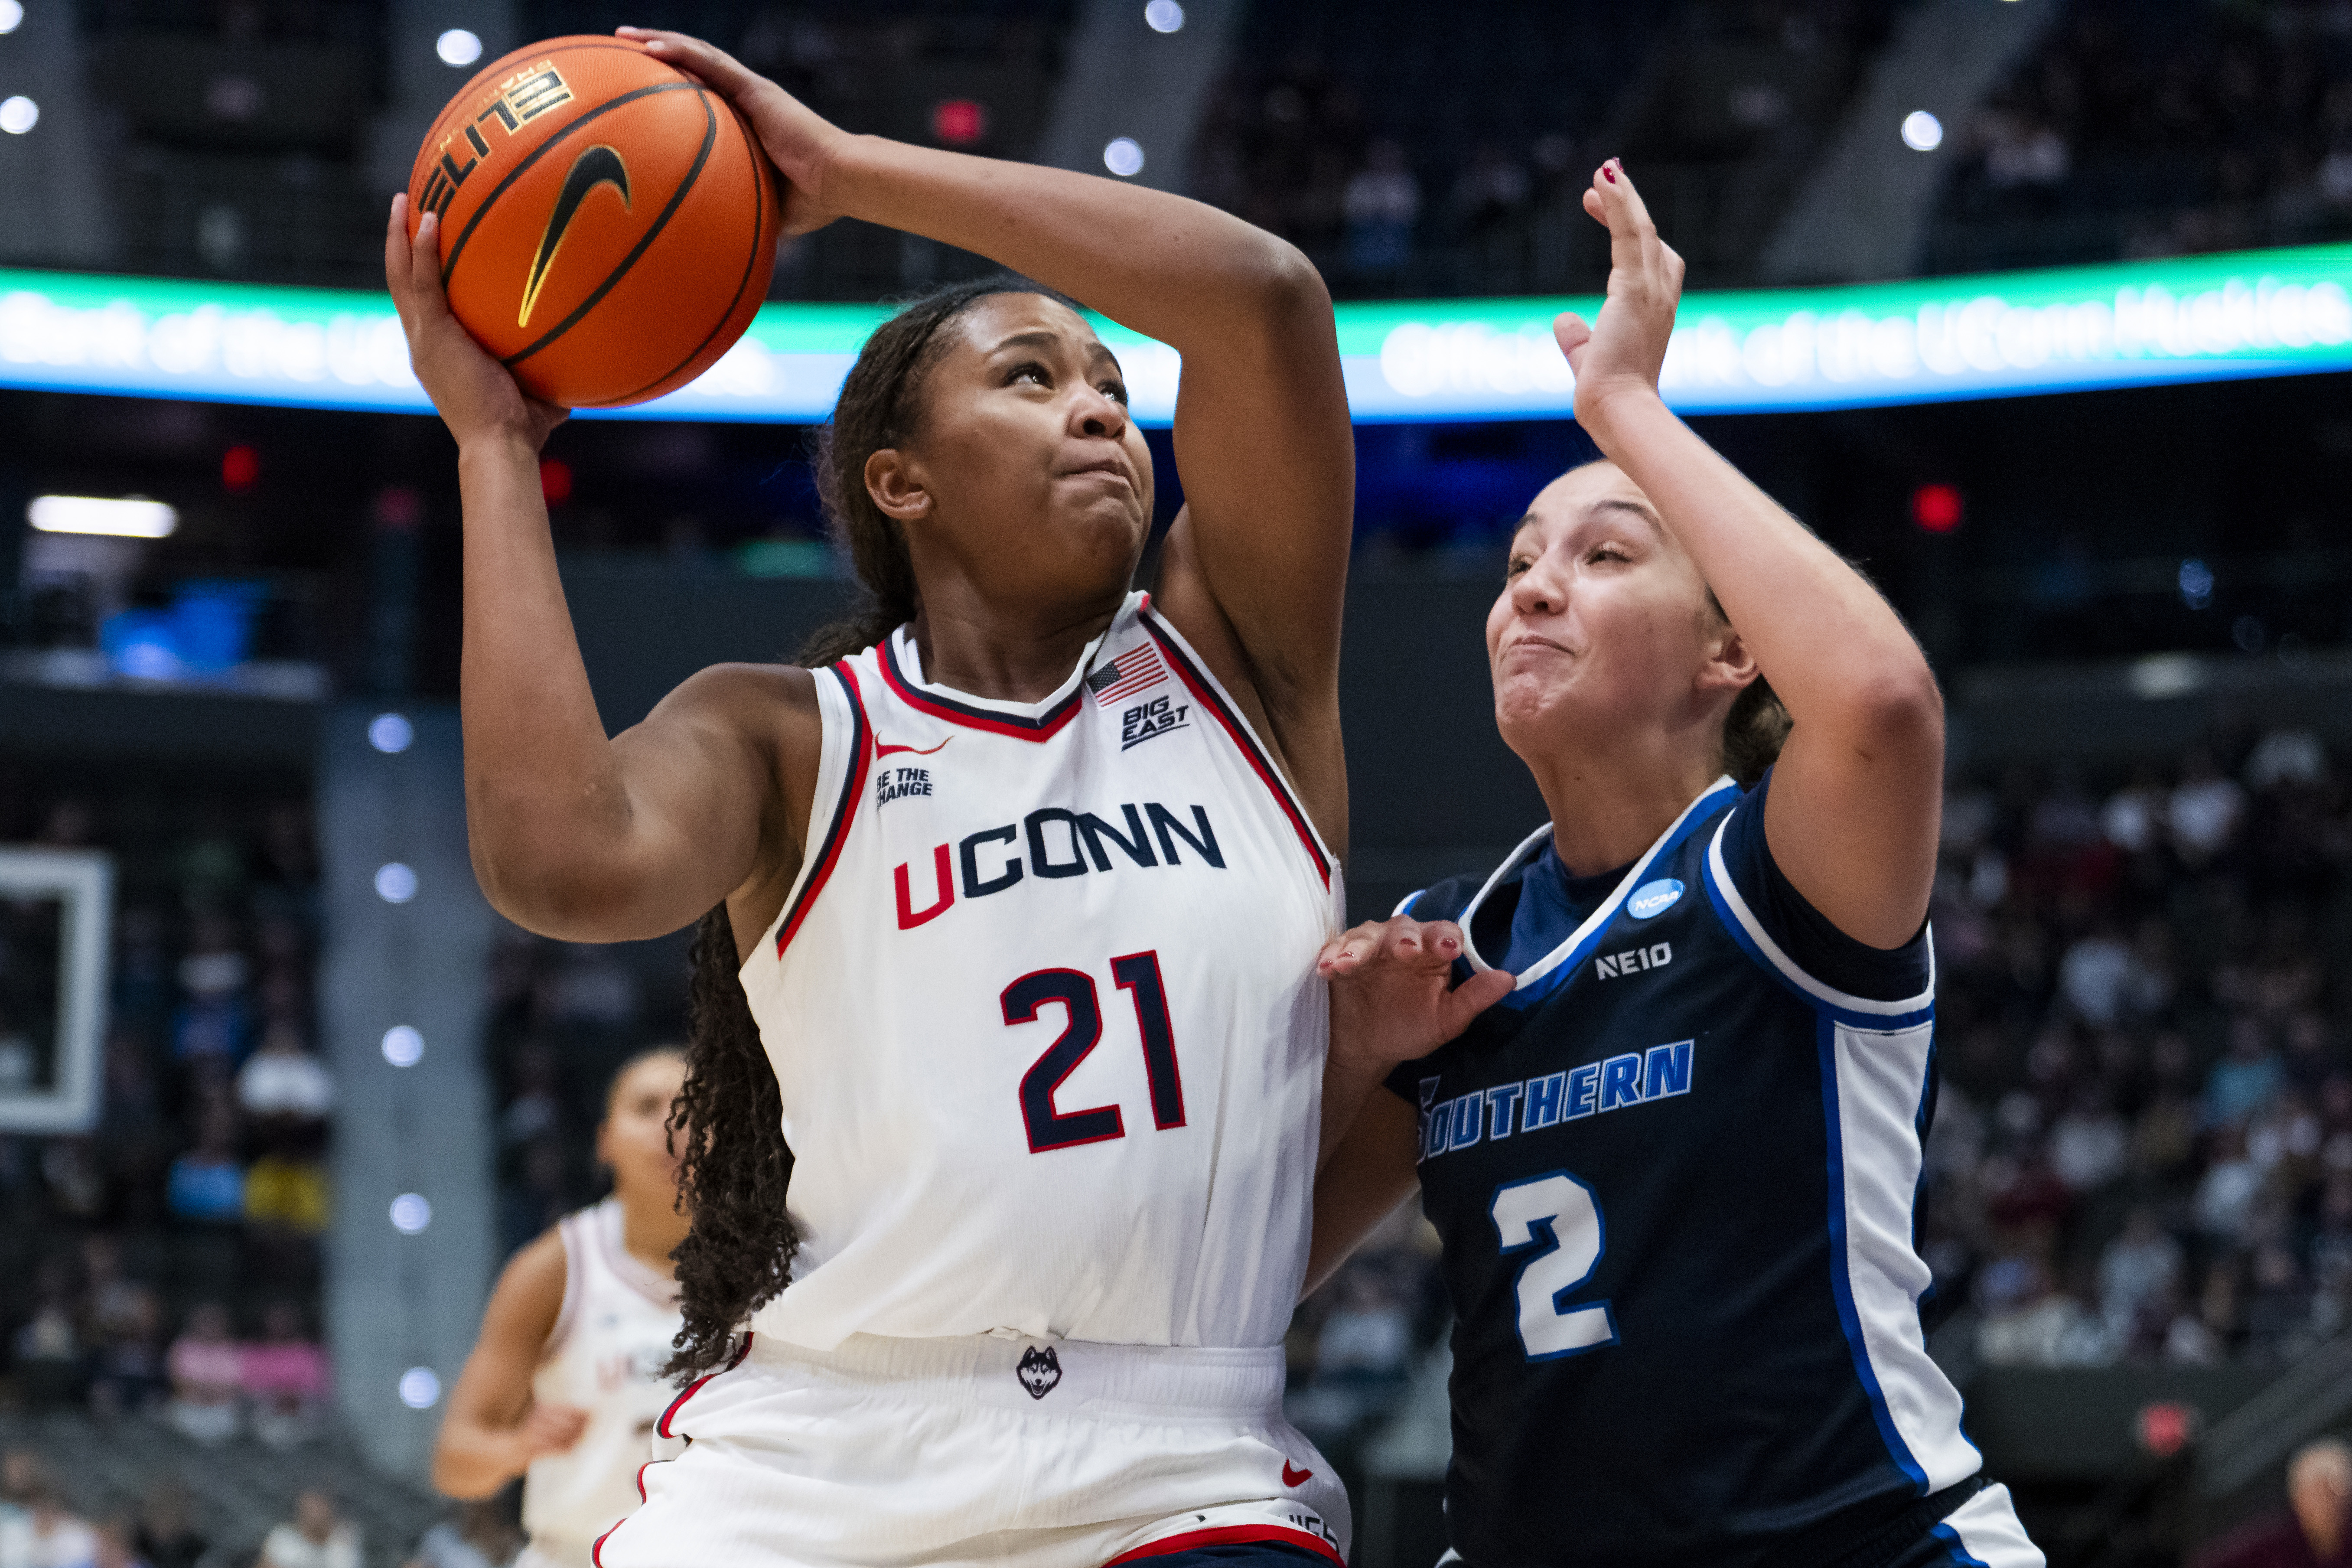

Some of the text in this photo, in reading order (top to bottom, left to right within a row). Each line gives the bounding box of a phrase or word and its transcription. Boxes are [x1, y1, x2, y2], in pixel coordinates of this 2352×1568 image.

[418, 65, 574, 225] ELITE
[1122, 705, 1189, 742] EAST
[1123, 694, 1169, 726] BIG
[877, 768, 930, 793] BE THE
[894, 802, 1227, 930] UCONN
[1635, 890, 1679, 911] NCAA
[1595, 942, 1672, 981] NE10
[1000, 949, 1187, 1154] 21
[1489, 1168, 1621, 1363] 2
